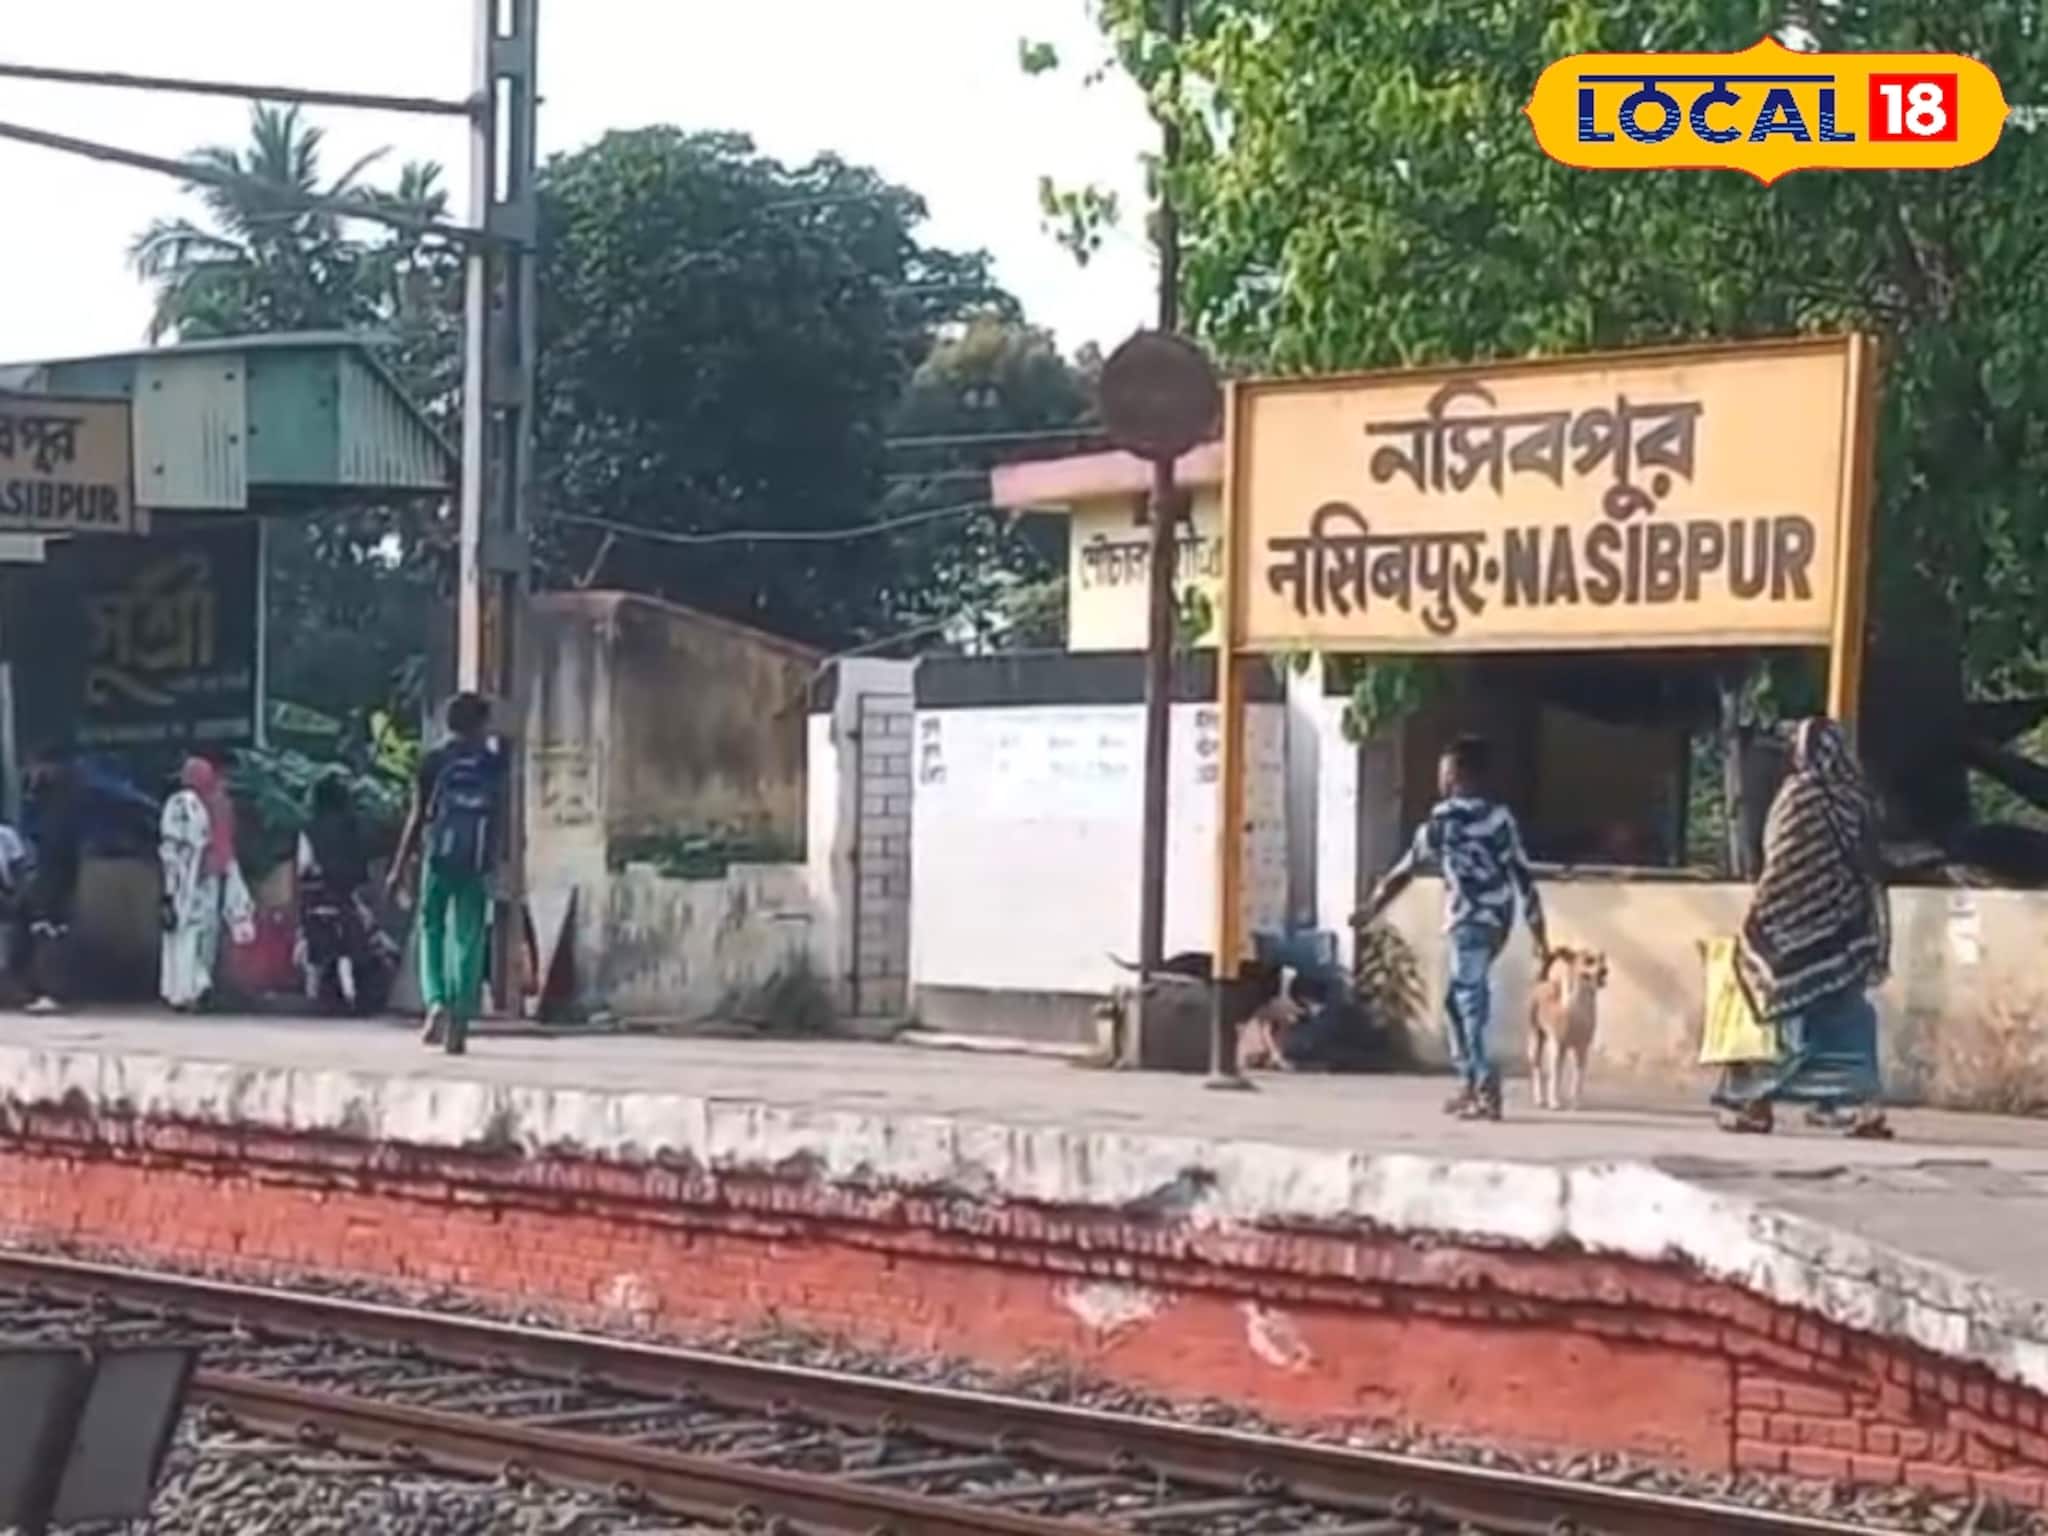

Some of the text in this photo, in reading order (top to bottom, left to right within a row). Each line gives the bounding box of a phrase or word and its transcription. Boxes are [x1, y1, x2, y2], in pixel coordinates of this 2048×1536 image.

[0, 479, 119, 523] SIBPUR
[1365, 379, 1703, 521] নসিবপুর
[1267, 501, 1486, 635] नसिबपुर
[1502, 515, 1817, 609] NASIBPUR
